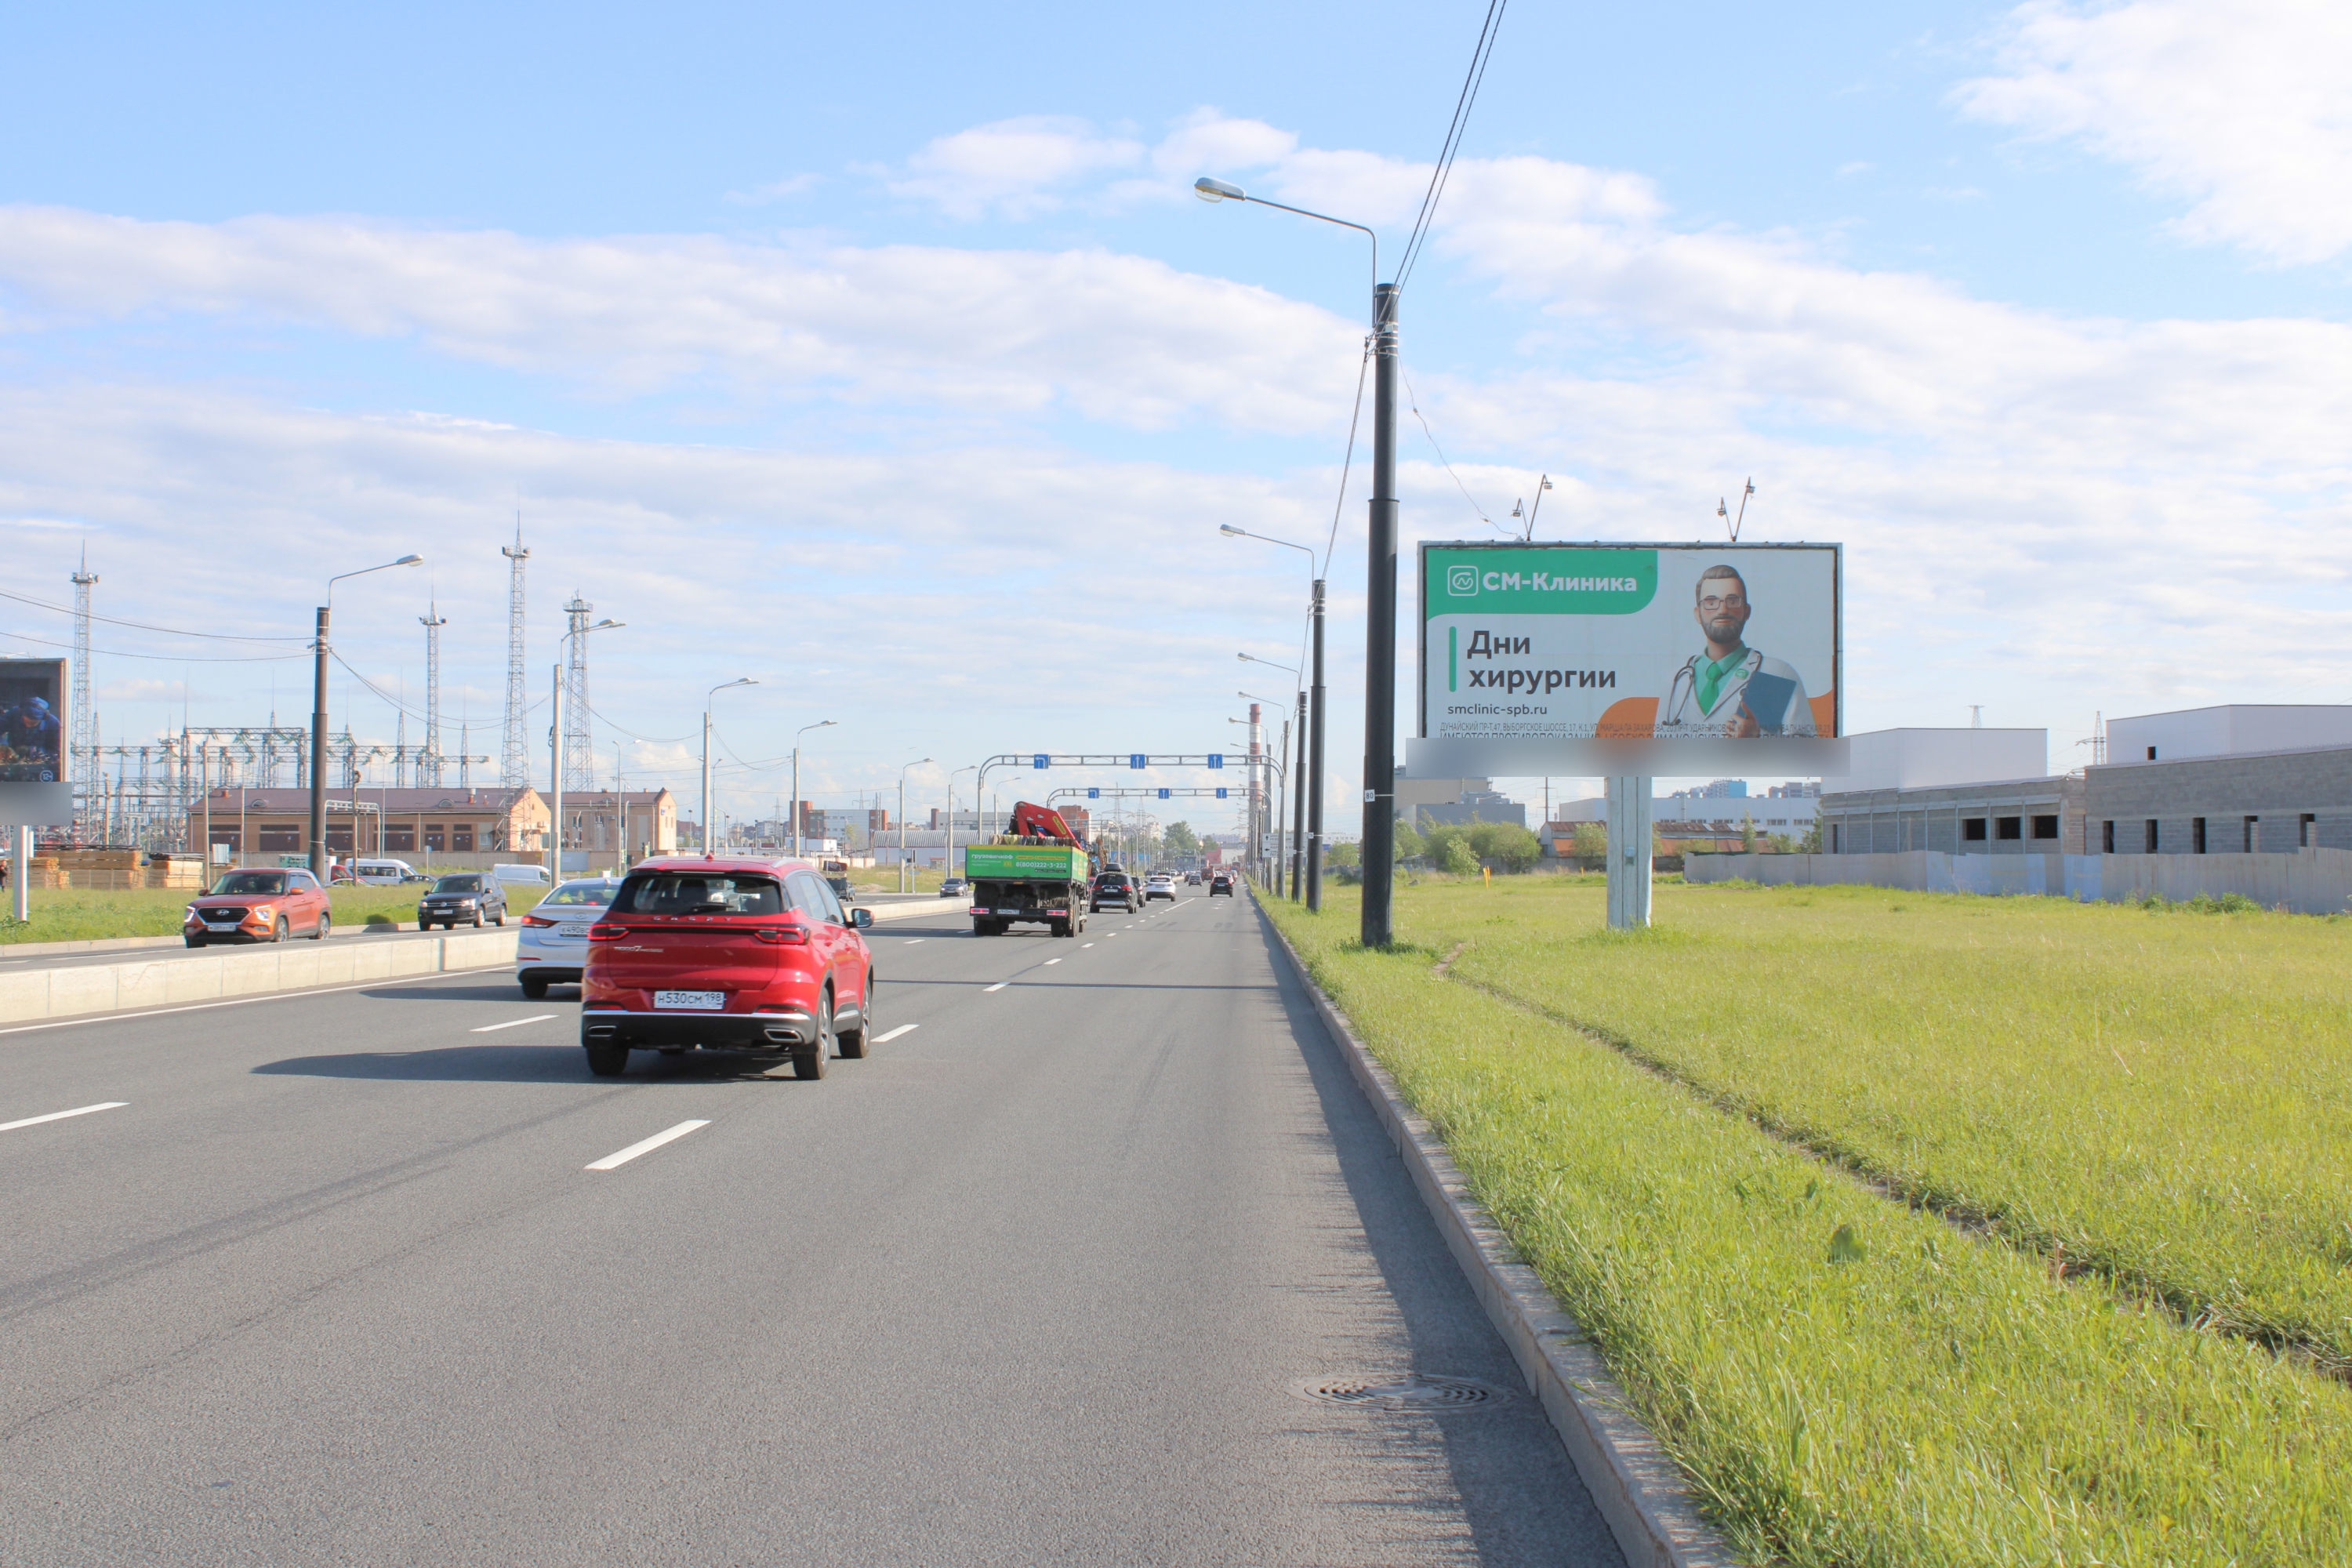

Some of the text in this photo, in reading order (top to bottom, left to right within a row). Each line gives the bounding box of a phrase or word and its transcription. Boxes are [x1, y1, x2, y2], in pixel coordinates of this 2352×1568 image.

[1483, 572, 1638, 591] СМ-Клиника
[1467, 630, 1530, 659] Дни
[1468, 670, 1616, 695] хирургии
[1447, 704, 1548, 717] smclinic-spb.ru
[1440, 721, 1479, 732] ДУНАЙСКИЙ
